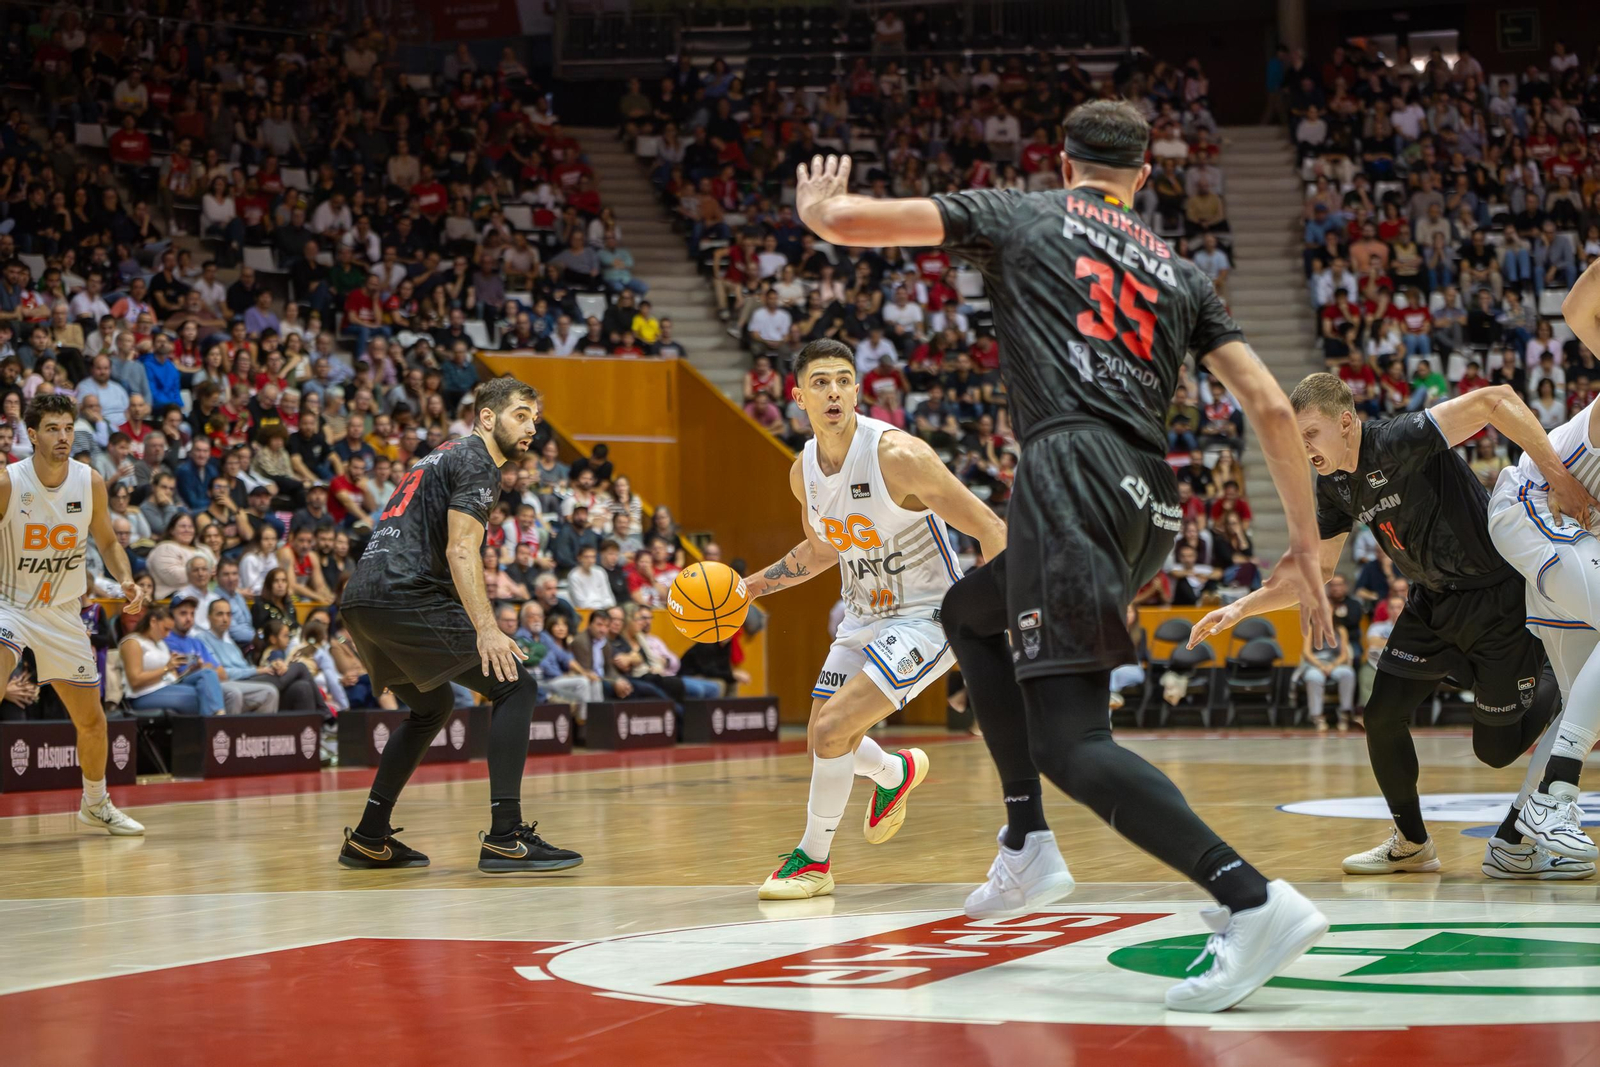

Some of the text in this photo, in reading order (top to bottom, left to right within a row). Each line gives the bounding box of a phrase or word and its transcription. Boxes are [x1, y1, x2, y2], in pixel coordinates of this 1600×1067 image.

[1075, 255, 1158, 362] 35
[22, 522, 79, 551] BG
[820, 513, 884, 552] BG
[17, 554, 82, 574] FIATC
[38, 581, 52, 605] 4
[1479, 703, 1517, 713] BERNER
[38, 742, 75, 770] BÀSQUET
[723, 912, 1122, 986] SPAR
